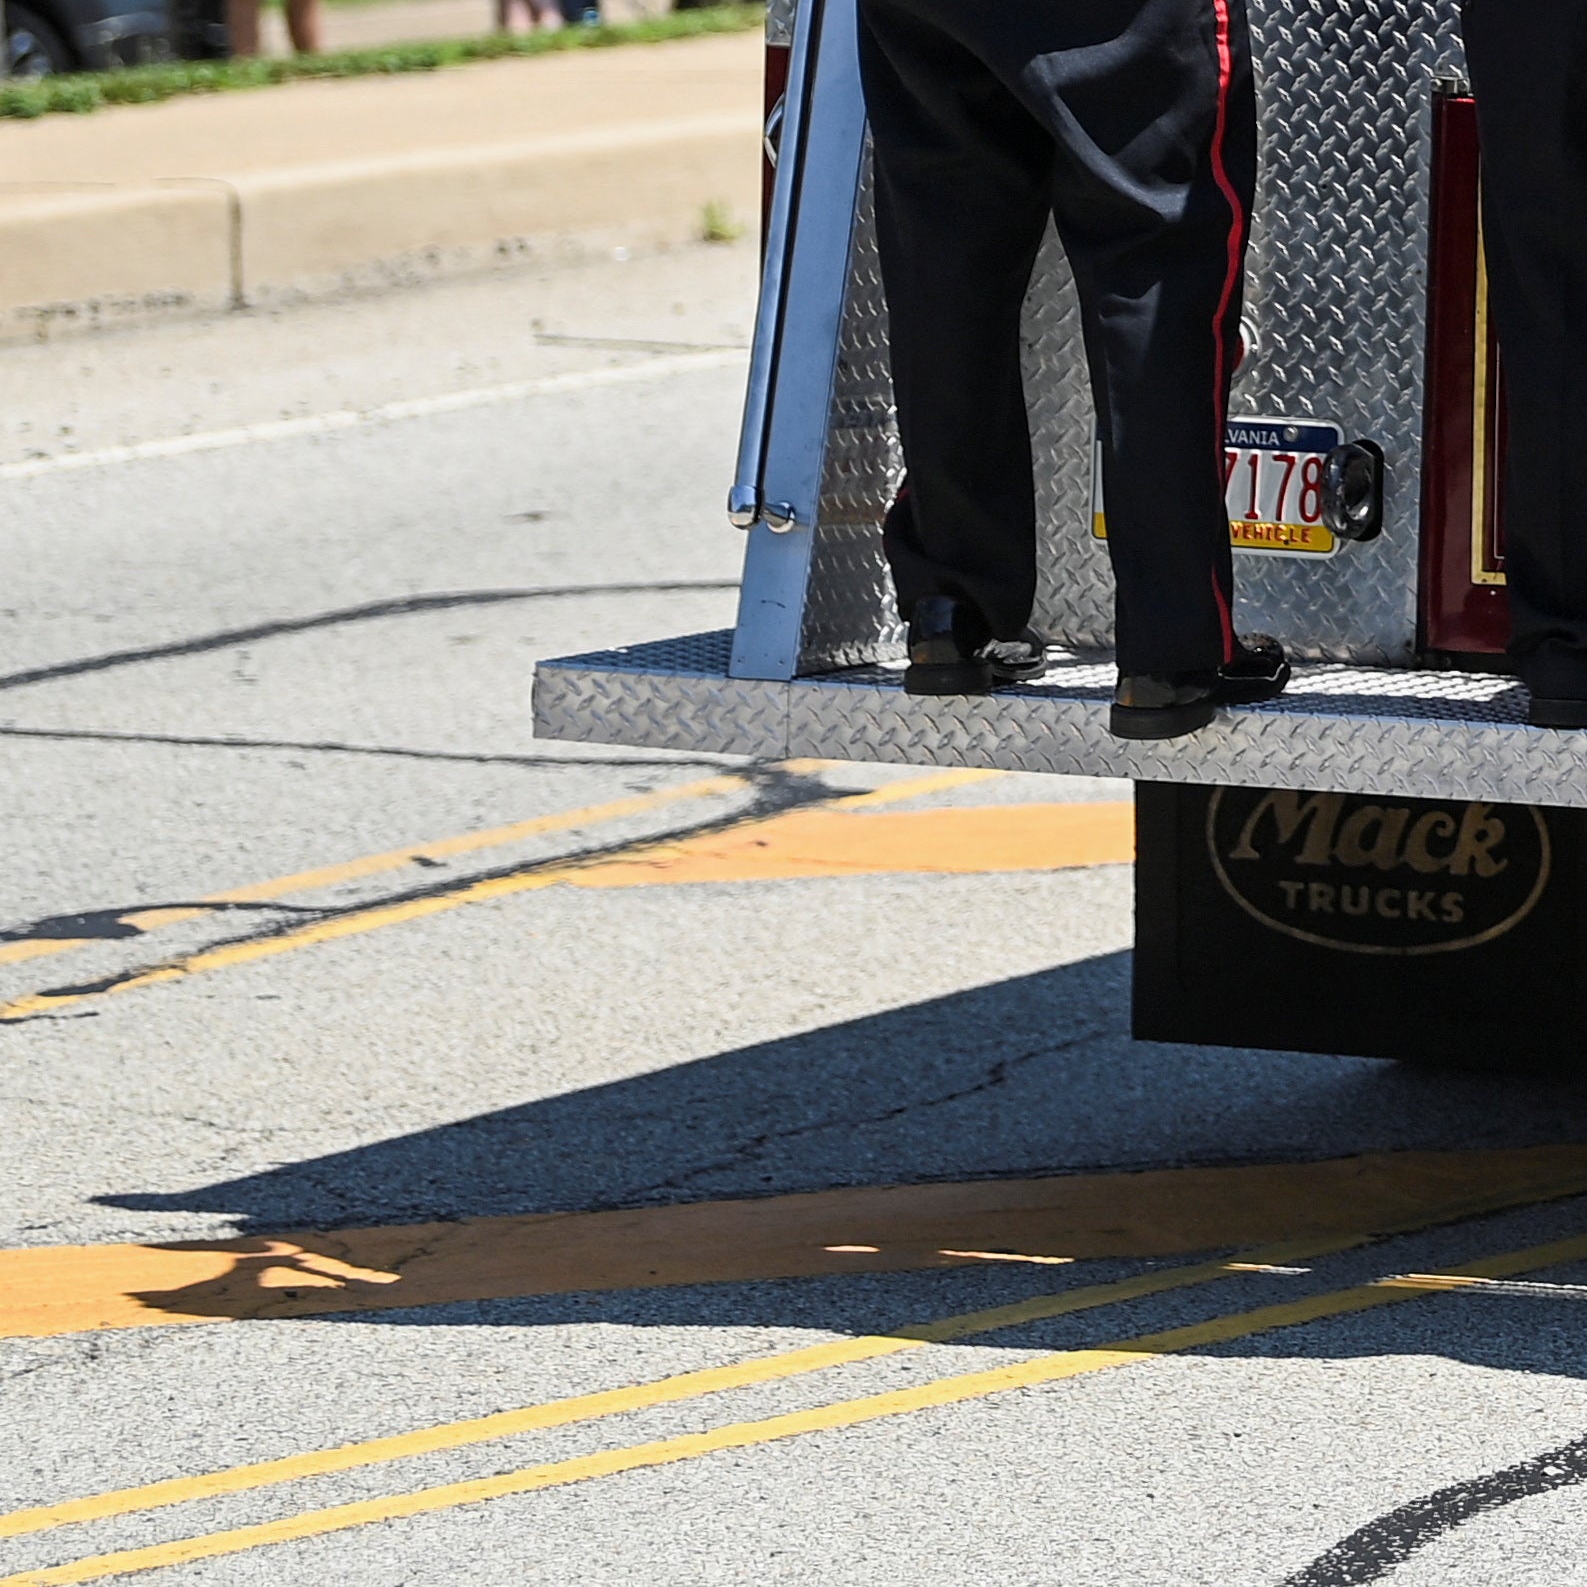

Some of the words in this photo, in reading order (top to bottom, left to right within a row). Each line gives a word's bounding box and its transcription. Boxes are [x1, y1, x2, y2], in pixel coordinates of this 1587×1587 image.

[1225, 428, 1280, 446] VANIA
[1231, 521, 1313, 544] VEHICLE
[1229, 789, 1509, 878] Mack
[1277, 880, 1465, 924] TRUCKS
